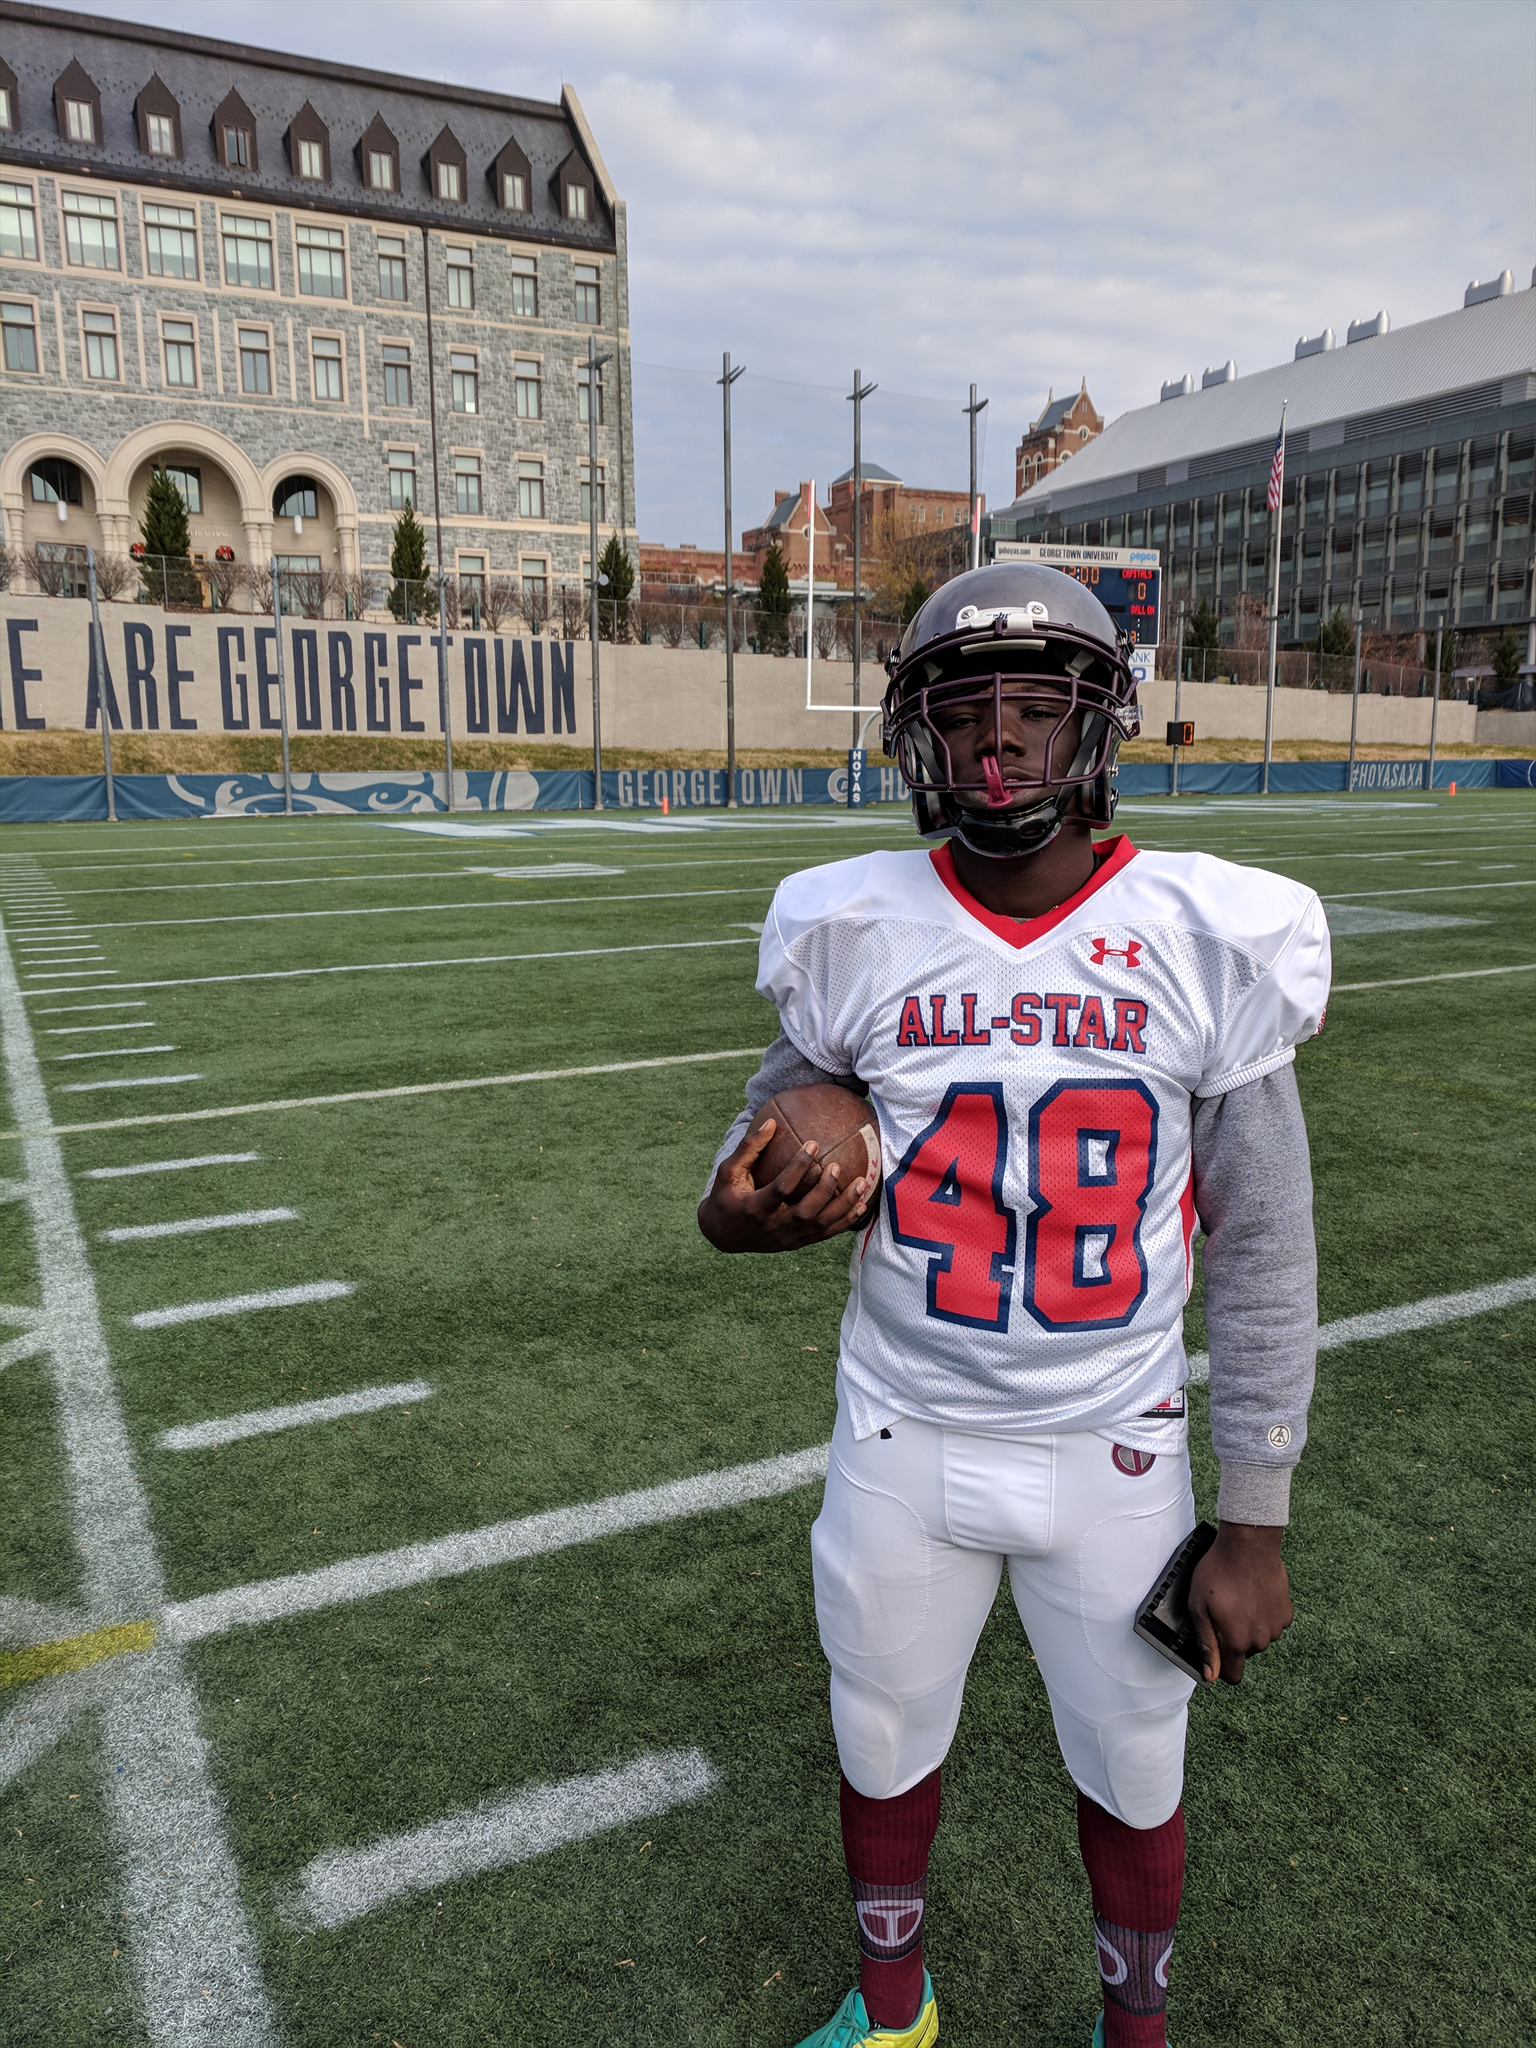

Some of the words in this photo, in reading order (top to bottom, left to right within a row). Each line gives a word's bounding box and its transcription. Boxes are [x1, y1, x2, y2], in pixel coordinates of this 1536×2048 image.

[1039, 547, 1081, 559] GEORGETOWN
[1083, 549, 1119, 561] UNIVERSITY
[1130, 552, 1157, 563] pepco
[1121, 569, 1153, 579] CAPITALS
[1137, 582, 1147, 600] 0
[0, 618, 47, 730] E
[84, 620, 199, 730] ARE
[216, 626, 577, 734] GEORGETOWN
[1183, 722, 1193, 744] 0
[617, 768, 803, 808] GEORGEOWN
[852, 750, 862, 803] HOYAS
[1352, 762, 1423, 788] #HOYASAXA
[897, 992, 1149, 1054] ALL-STAR
[884, 1077, 1159, 1334] 48
